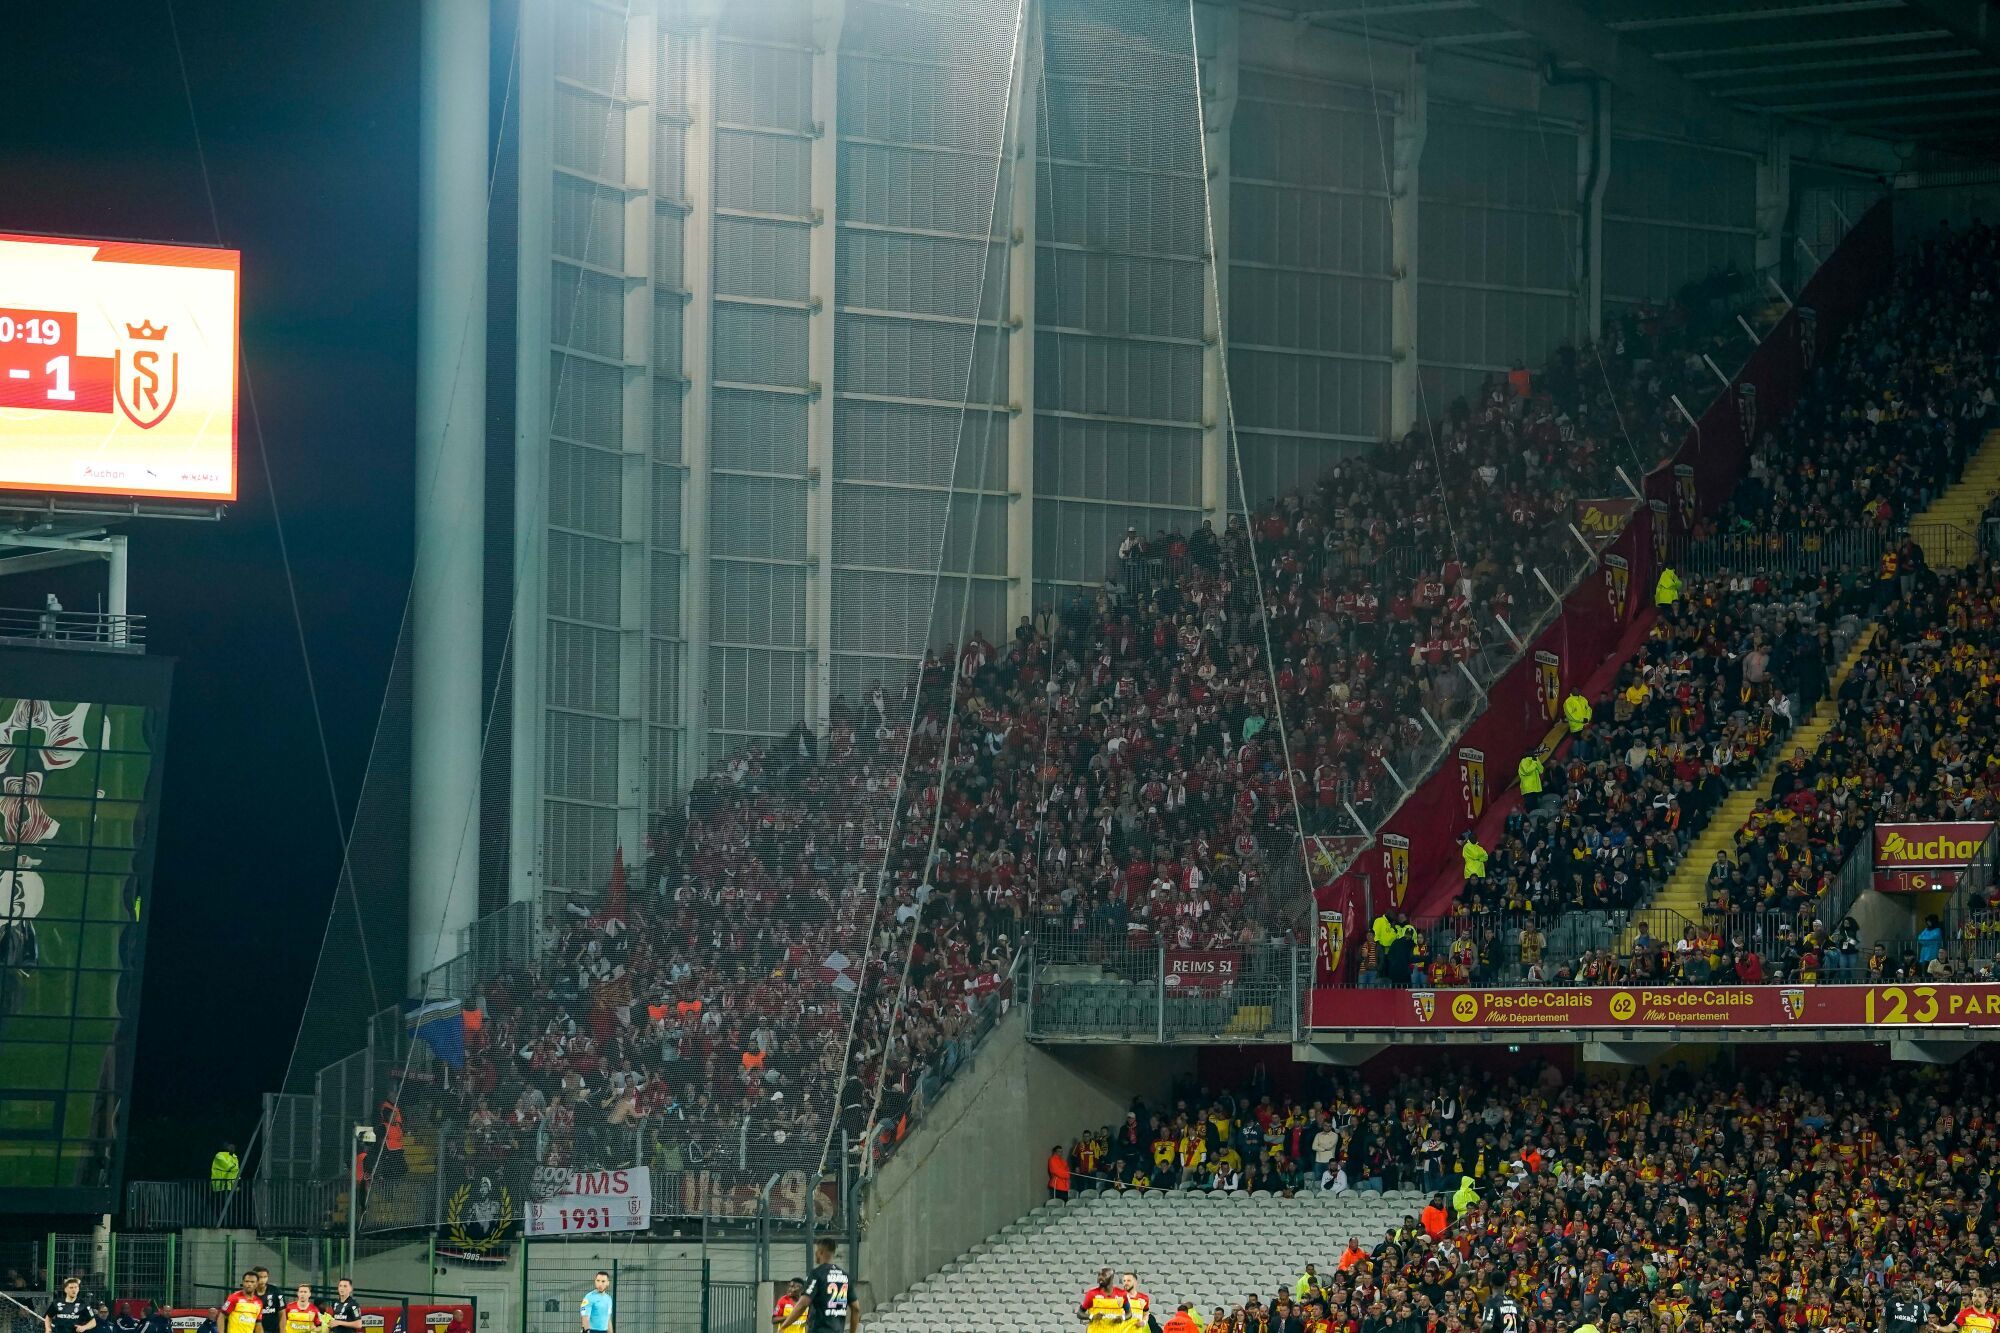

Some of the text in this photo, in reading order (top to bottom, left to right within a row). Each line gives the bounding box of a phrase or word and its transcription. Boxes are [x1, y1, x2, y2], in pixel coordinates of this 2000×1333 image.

[45, 355, 76, 400] 1
[1535, 667, 1548, 721] RCL
[1460, 765, 1474, 820] RCL
[1383, 851, 1397, 907] RCL
[1173, 960, 1233, 973] REIMS 51
[1413, 1000, 1426, 1022] RCL
[1455, 1001, 1474, 1015] 62
[1484, 1010, 1569, 1023] Mon Département
[1613, 998, 1632, 1013] 62
[1643, 1009, 1729, 1022] Mon Département
[1781, 997, 1795, 1020] RCL
[1865, 986, 1939, 1024] 123
[560, 1207, 610, 1230] 1931
[827, 1283, 849, 1309] 24
